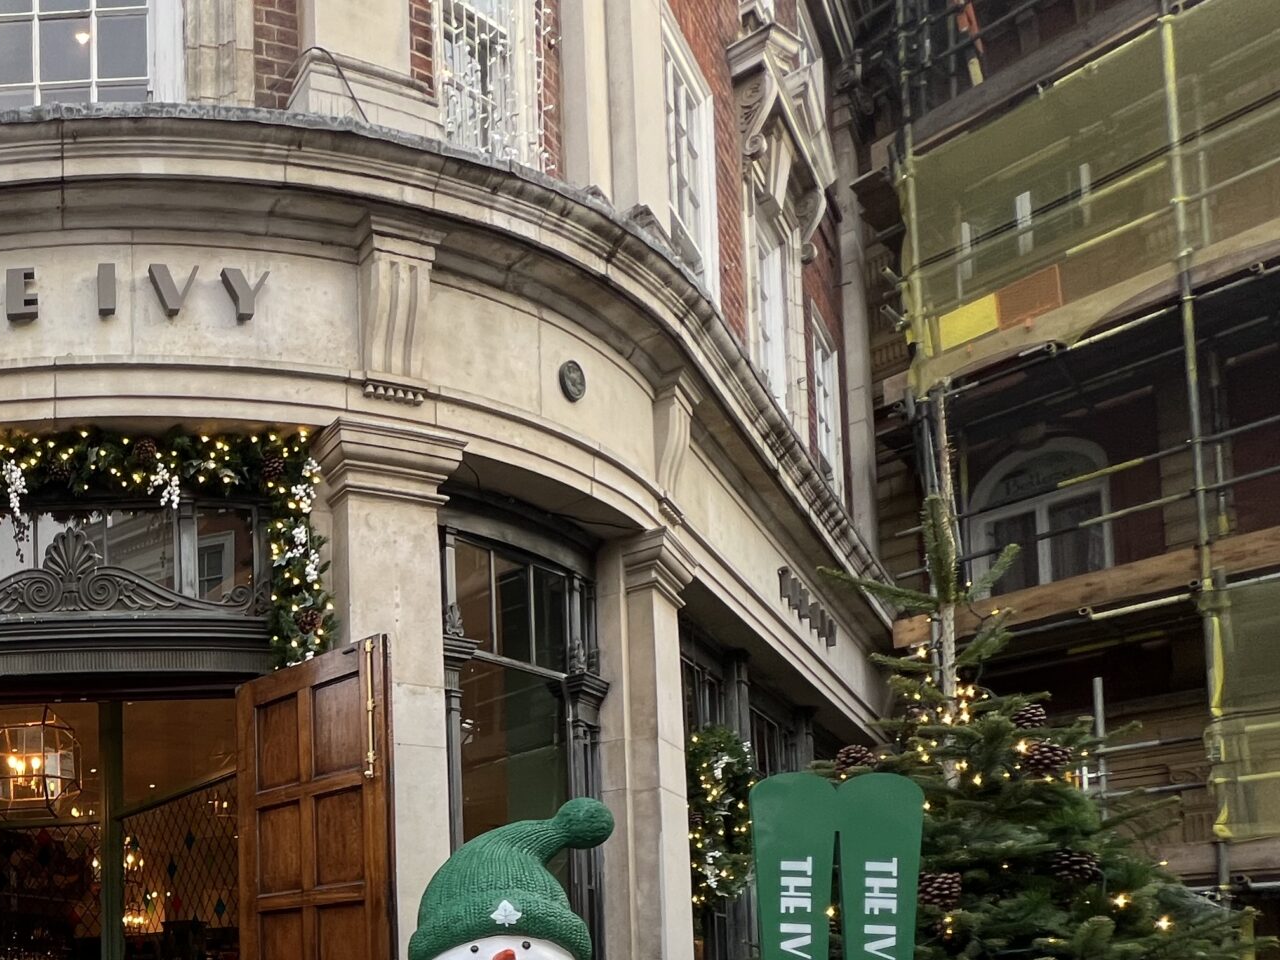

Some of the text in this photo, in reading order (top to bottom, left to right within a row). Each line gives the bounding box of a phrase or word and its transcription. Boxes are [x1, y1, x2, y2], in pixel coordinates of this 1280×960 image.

[96, 263, 271, 321] IVY
[780, 856, 812, 914] THE
[864, 857, 898, 915] THE
